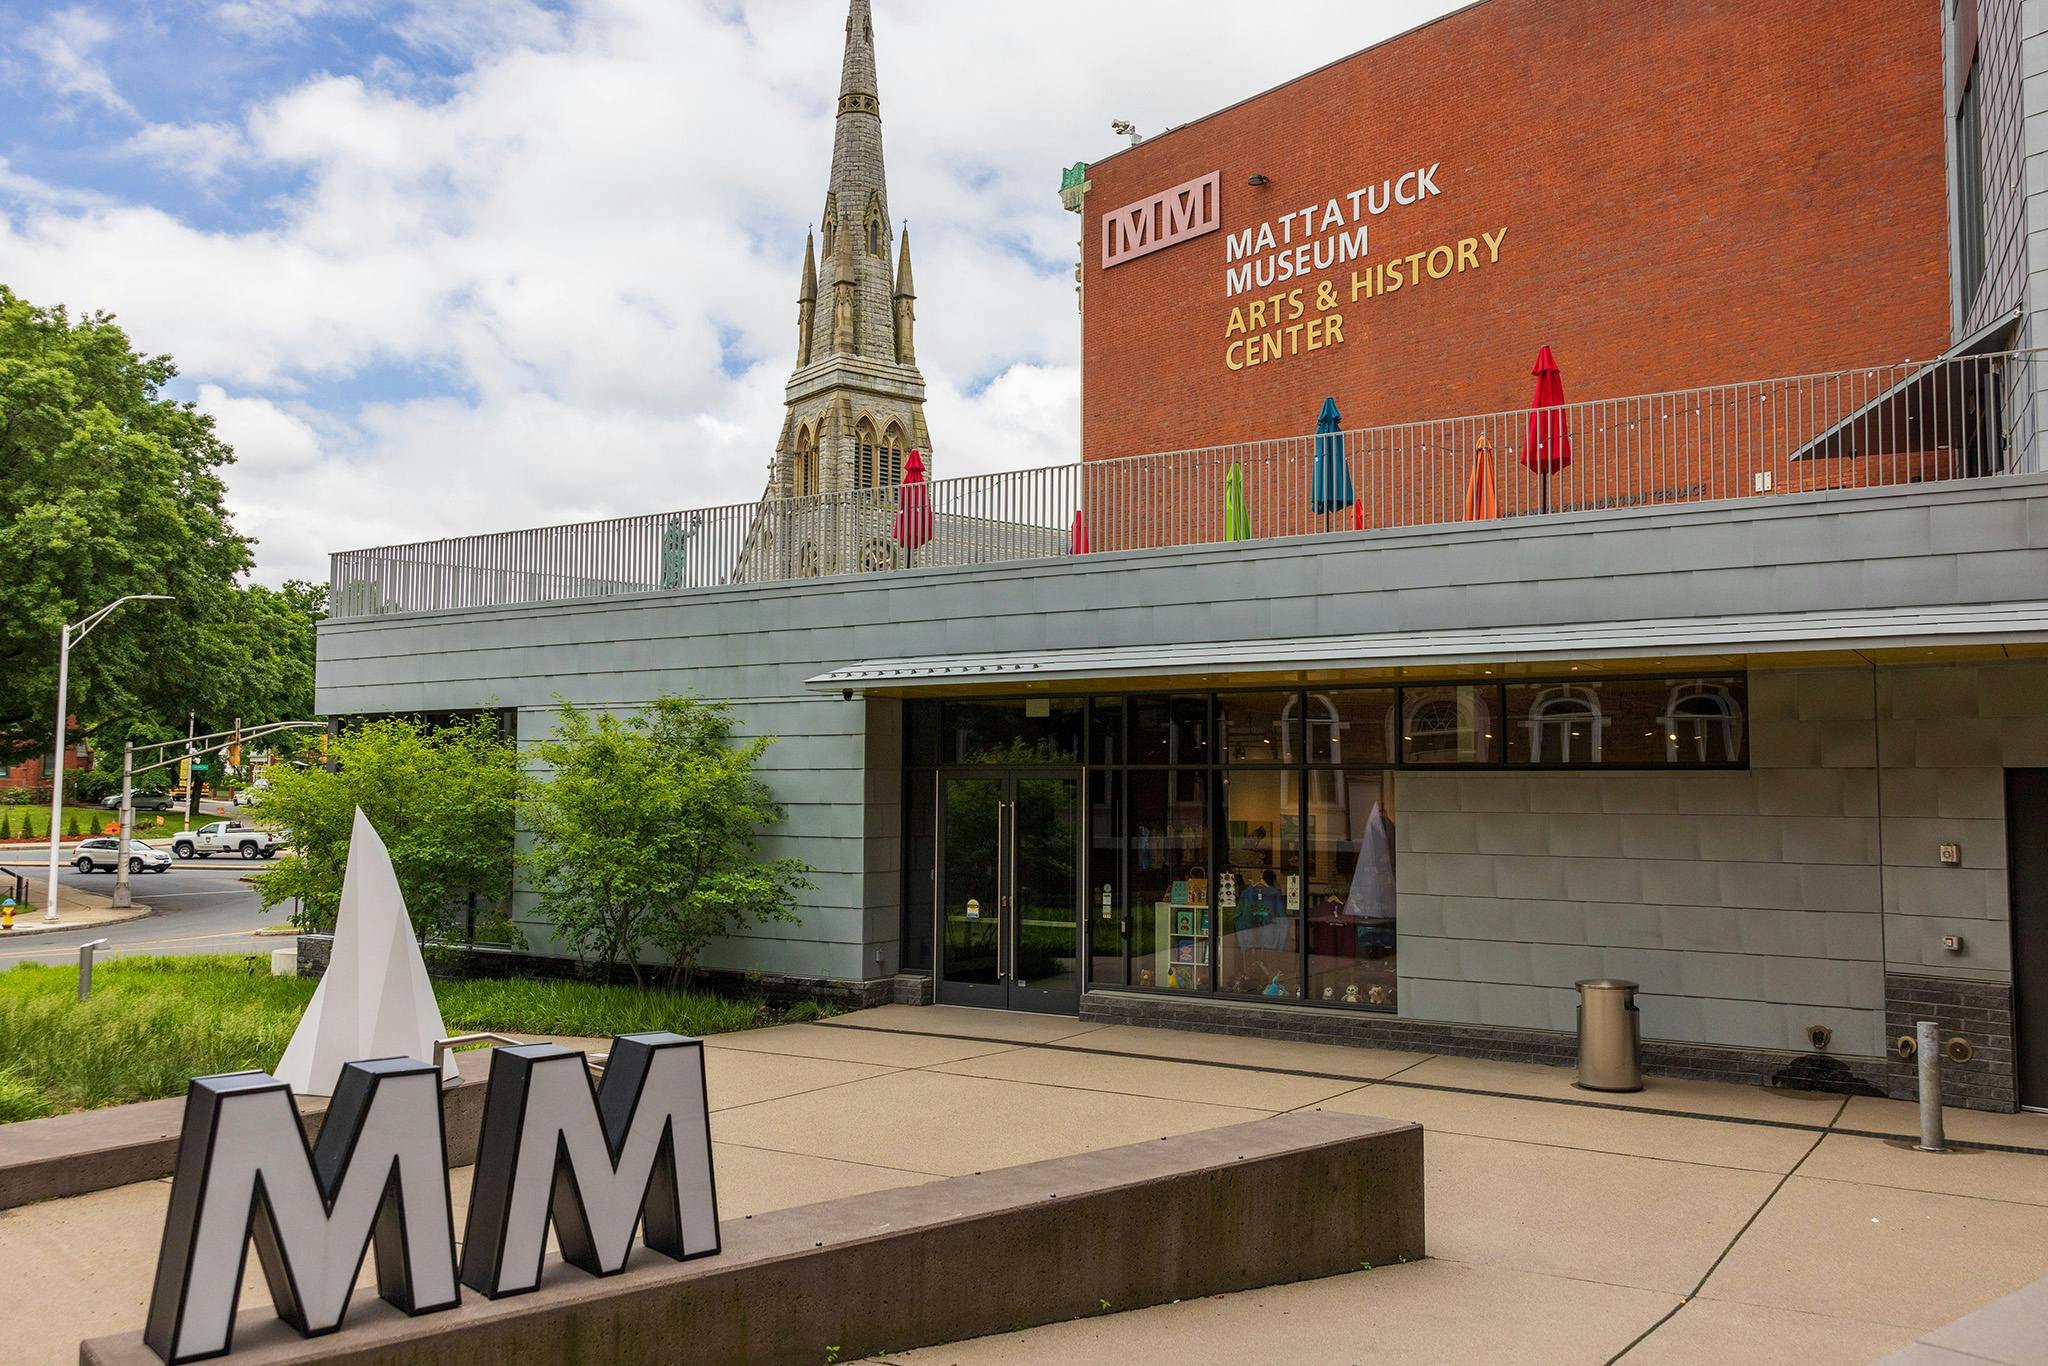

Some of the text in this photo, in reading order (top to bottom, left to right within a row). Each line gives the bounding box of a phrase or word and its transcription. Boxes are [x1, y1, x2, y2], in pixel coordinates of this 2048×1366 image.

[1226, 162, 1441, 264] MATTATUCK
[1225, 226, 1508, 338] ARTS & HISTORY
[1226, 225, 1369, 298] MUSEUM
[1225, 313, 1345, 371] CENTER
